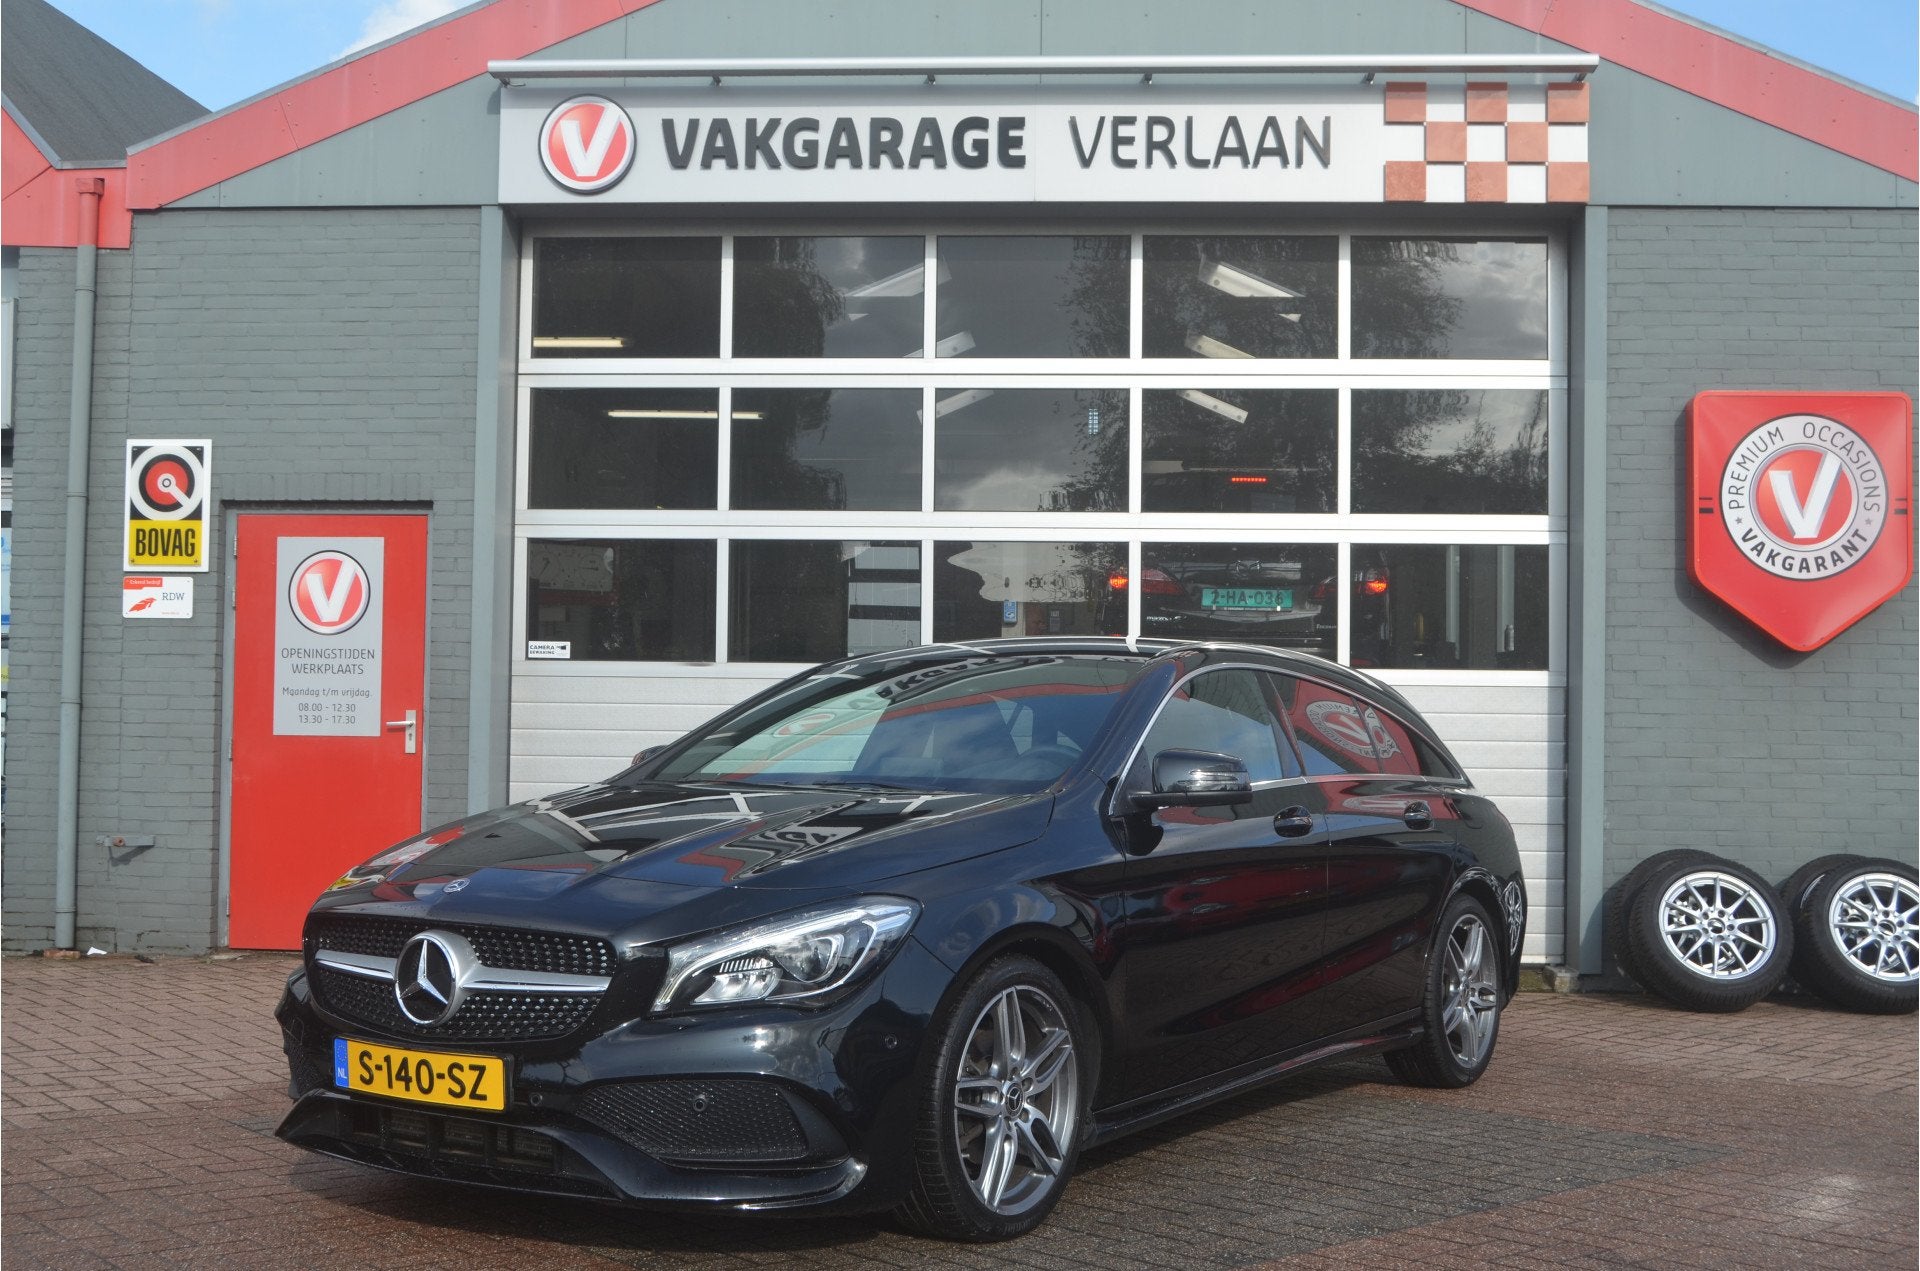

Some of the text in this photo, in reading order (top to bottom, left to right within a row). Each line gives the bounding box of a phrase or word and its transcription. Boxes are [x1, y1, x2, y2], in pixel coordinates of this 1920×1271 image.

[661, 115, 1331, 170] VAKGARAGE VERLAAN
[1728, 422, 1880, 513] PREMIUM OCCASIONS
[135, 528, 196, 557] BOVAG
[1741, 528, 1868, 574] VAKGARANT
[162, 592, 185, 601] RDW
[281, 647, 375, 660] OPENINGSTIJDEN
[291, 663, 364, 675] WERKPLAATS
[322, 687, 339, 697] t/m
[298, 702, 323, 712] 08.00
[332, 703, 356, 713] 12.30
[298, 714, 323, 724] 13.30
[332, 715, 356, 724] 17.30
[337, 1067, 348, 1079] NL
[358, 1049, 488, 1102] S-140-SZ
